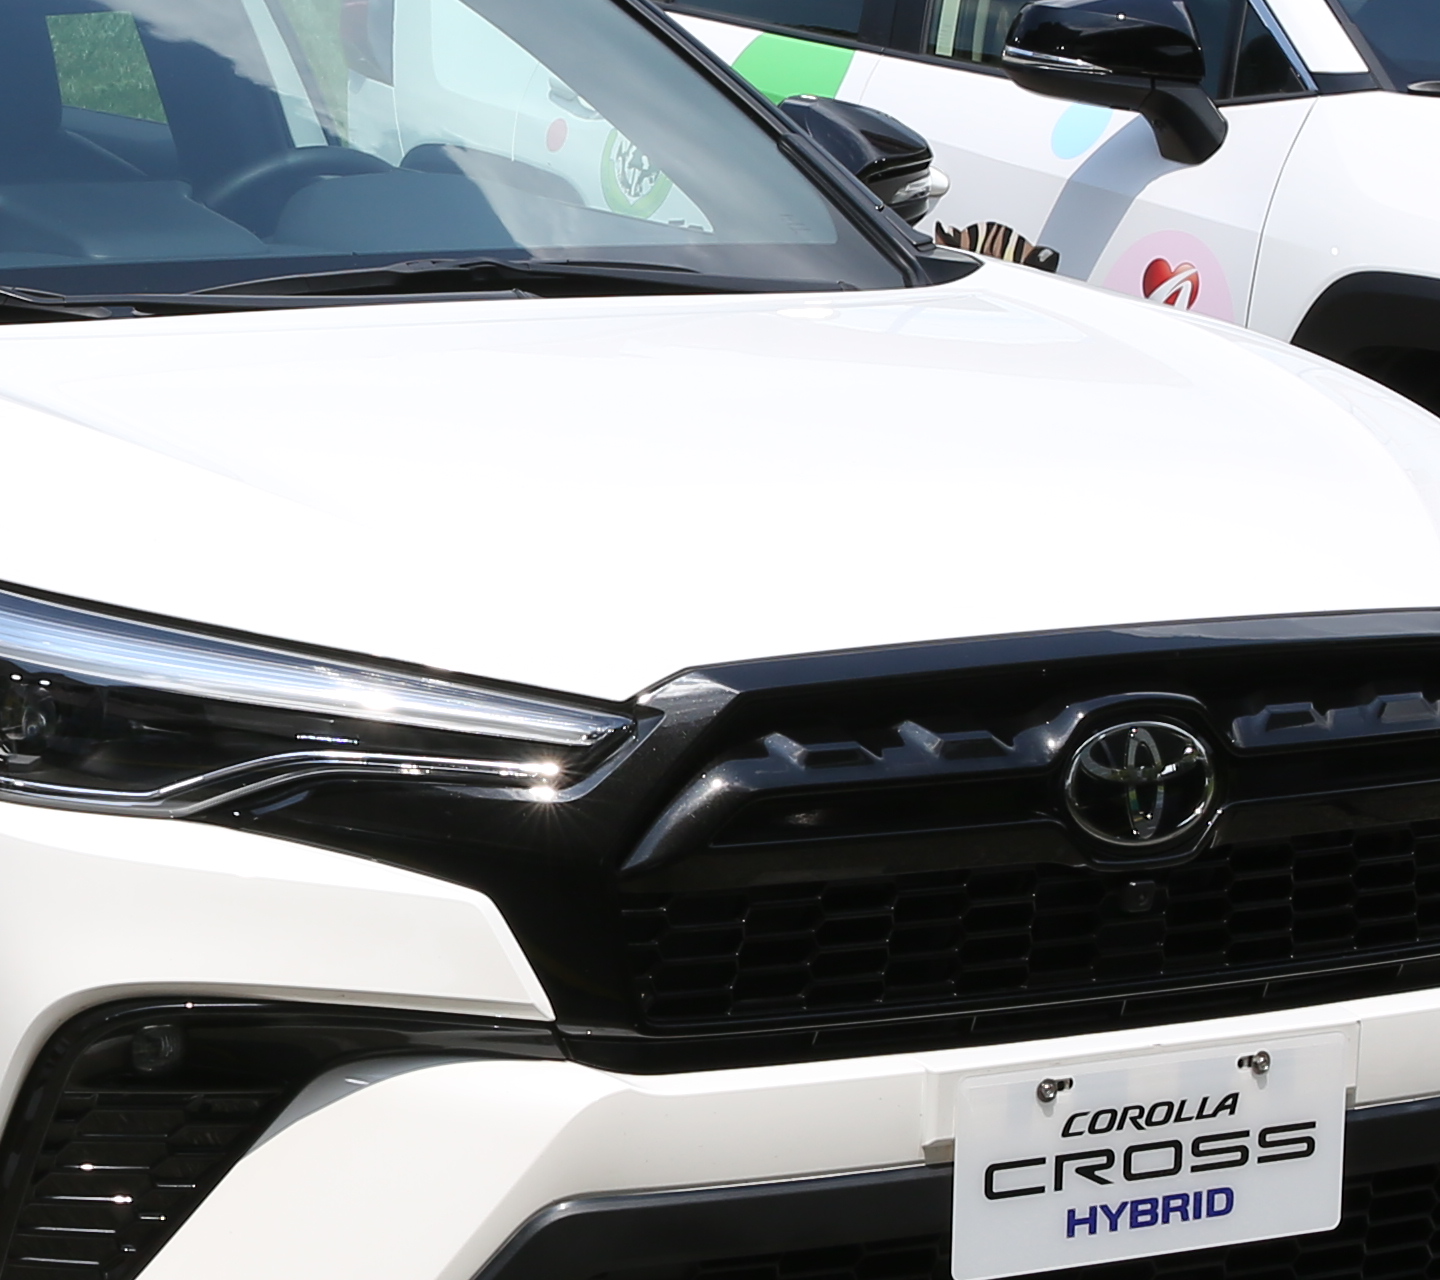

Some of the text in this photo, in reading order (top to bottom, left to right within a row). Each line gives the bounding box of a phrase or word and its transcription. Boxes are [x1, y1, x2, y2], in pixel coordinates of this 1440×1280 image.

[1060, 1092, 1240, 1138] COROLLA
[983, 1121, 1317, 1200] CROSS
[1066, 1187, 1235, 1238] HYBRID
